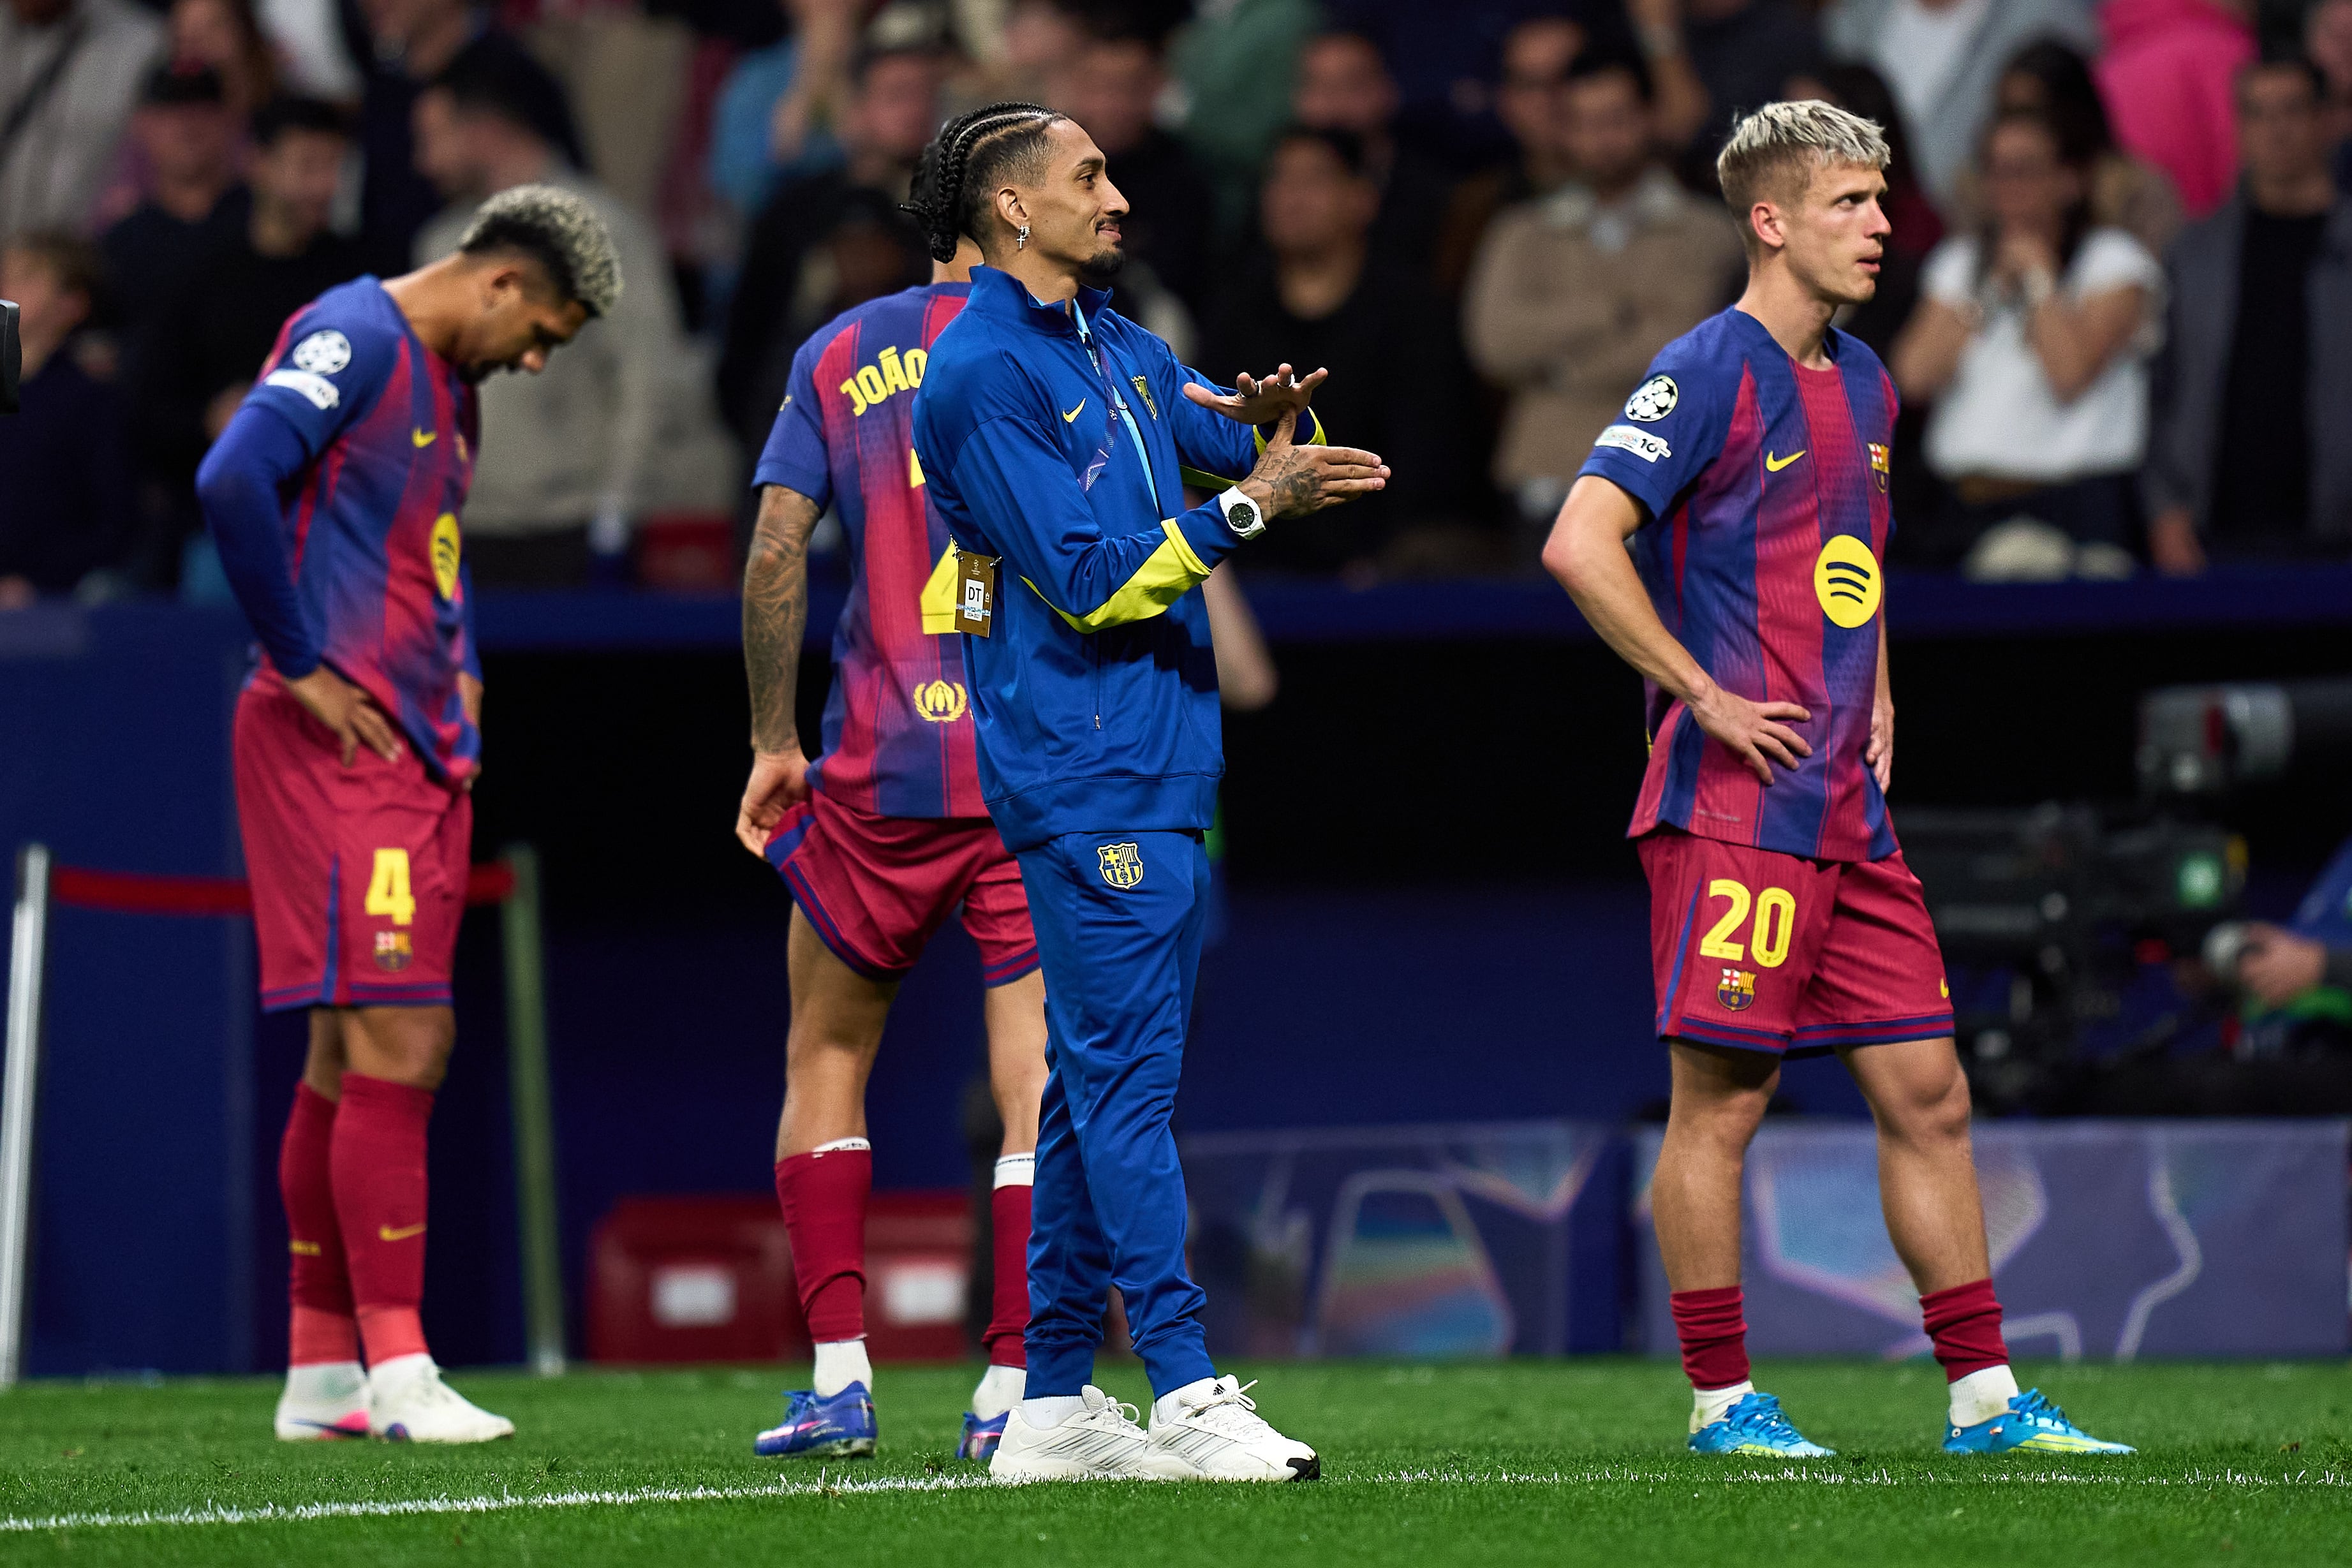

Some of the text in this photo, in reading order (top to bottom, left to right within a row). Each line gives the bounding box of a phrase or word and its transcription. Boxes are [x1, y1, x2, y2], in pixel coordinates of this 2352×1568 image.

[839, 346, 928, 417] JOÃO
[968, 586, 982, 602] DT
[365, 847, 416, 926] 4
[1699, 878, 1796, 968] 20
